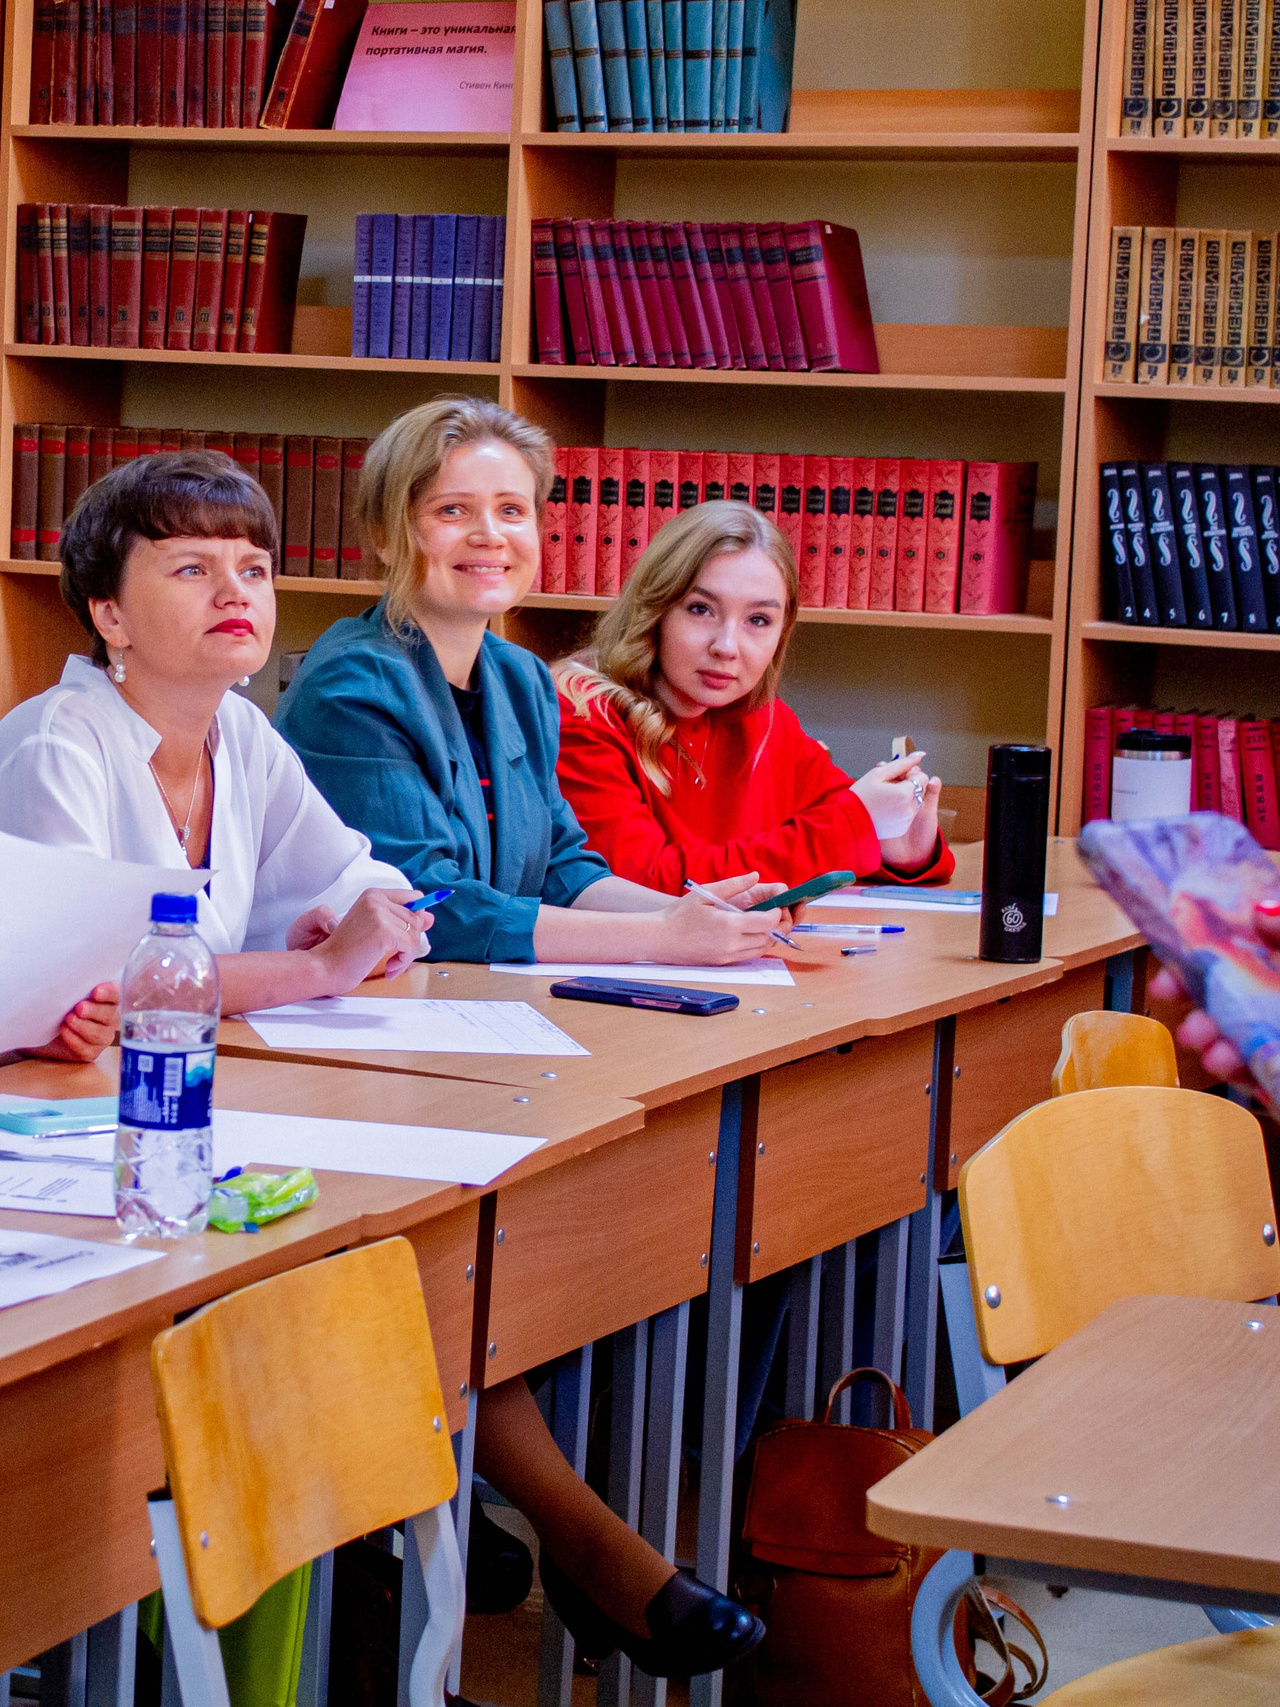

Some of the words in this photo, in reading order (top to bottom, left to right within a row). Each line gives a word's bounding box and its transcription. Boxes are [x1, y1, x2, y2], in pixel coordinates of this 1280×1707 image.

[371, 26, 408, 35] Книги
[421, 26, 440, 35] это
[443, 25, 516, 36] уникальная
[366, 46, 443, 57] портативная
[446, 45, 487, 54] магия.
[459, 81, 491, 90] Стивен
[1107, 236, 1131, 361] СТЕНДАЛЬ
[1143, 239, 1166, 362] СТЕНДАЛЬ
[1174, 238, 1195, 362] СТЕНДАЛЬ
[1199, 241, 1220, 365] СТЕНДАЛЬ
[1224, 241, 1246, 366] СТЕНДАЛЬ
[1251, 241, 1271, 365] СТЕНДАЛЬ
[1125, 606, 1132, 617] 2
[1143, 608, 1150, 618] 4
[1169, 608, 1176, 619] 5
[1198, 610, 1205, 620] 6
[1221, 612, 1228, 623] 7
[1248, 613, 1256, 624] 8
[1006, 912, 1019, 924] 60
